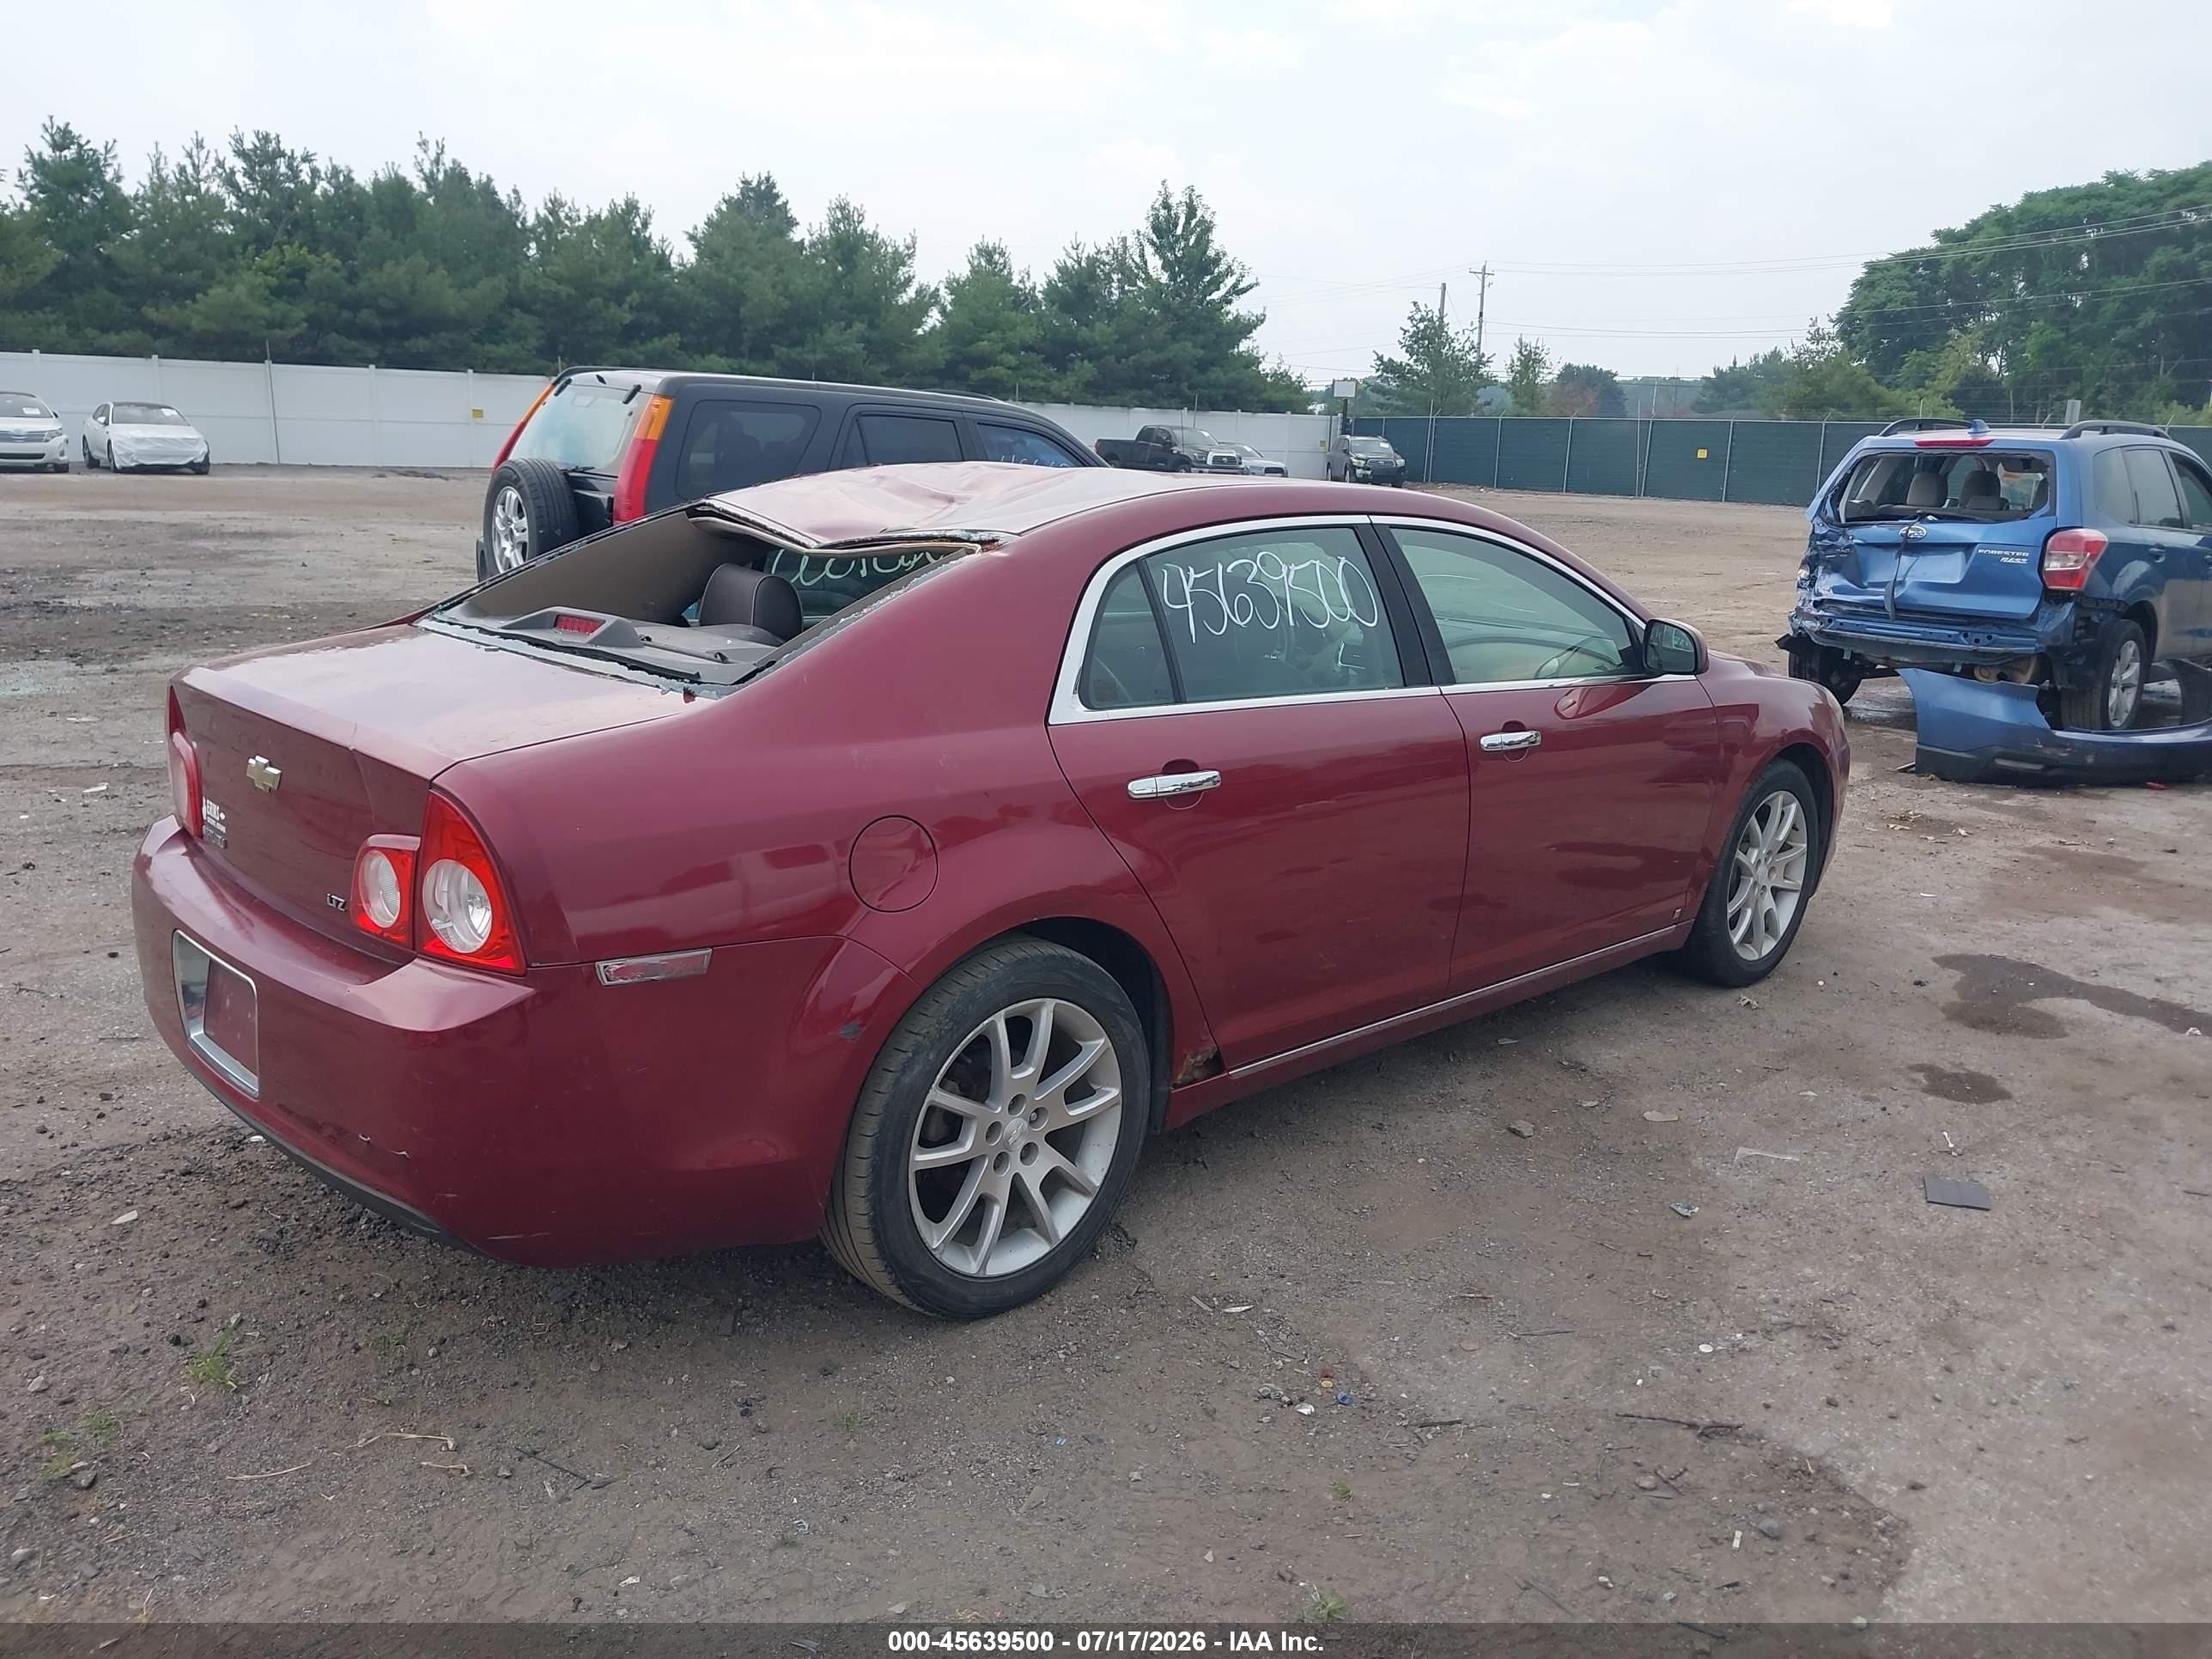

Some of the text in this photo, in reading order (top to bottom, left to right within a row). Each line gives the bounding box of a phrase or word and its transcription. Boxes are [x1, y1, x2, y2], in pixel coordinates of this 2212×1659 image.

[1978, 549, 2030, 557] FORESTER
[1161, 550, 1378, 644] 45639500
[326, 893, 345, 912] LTZ
